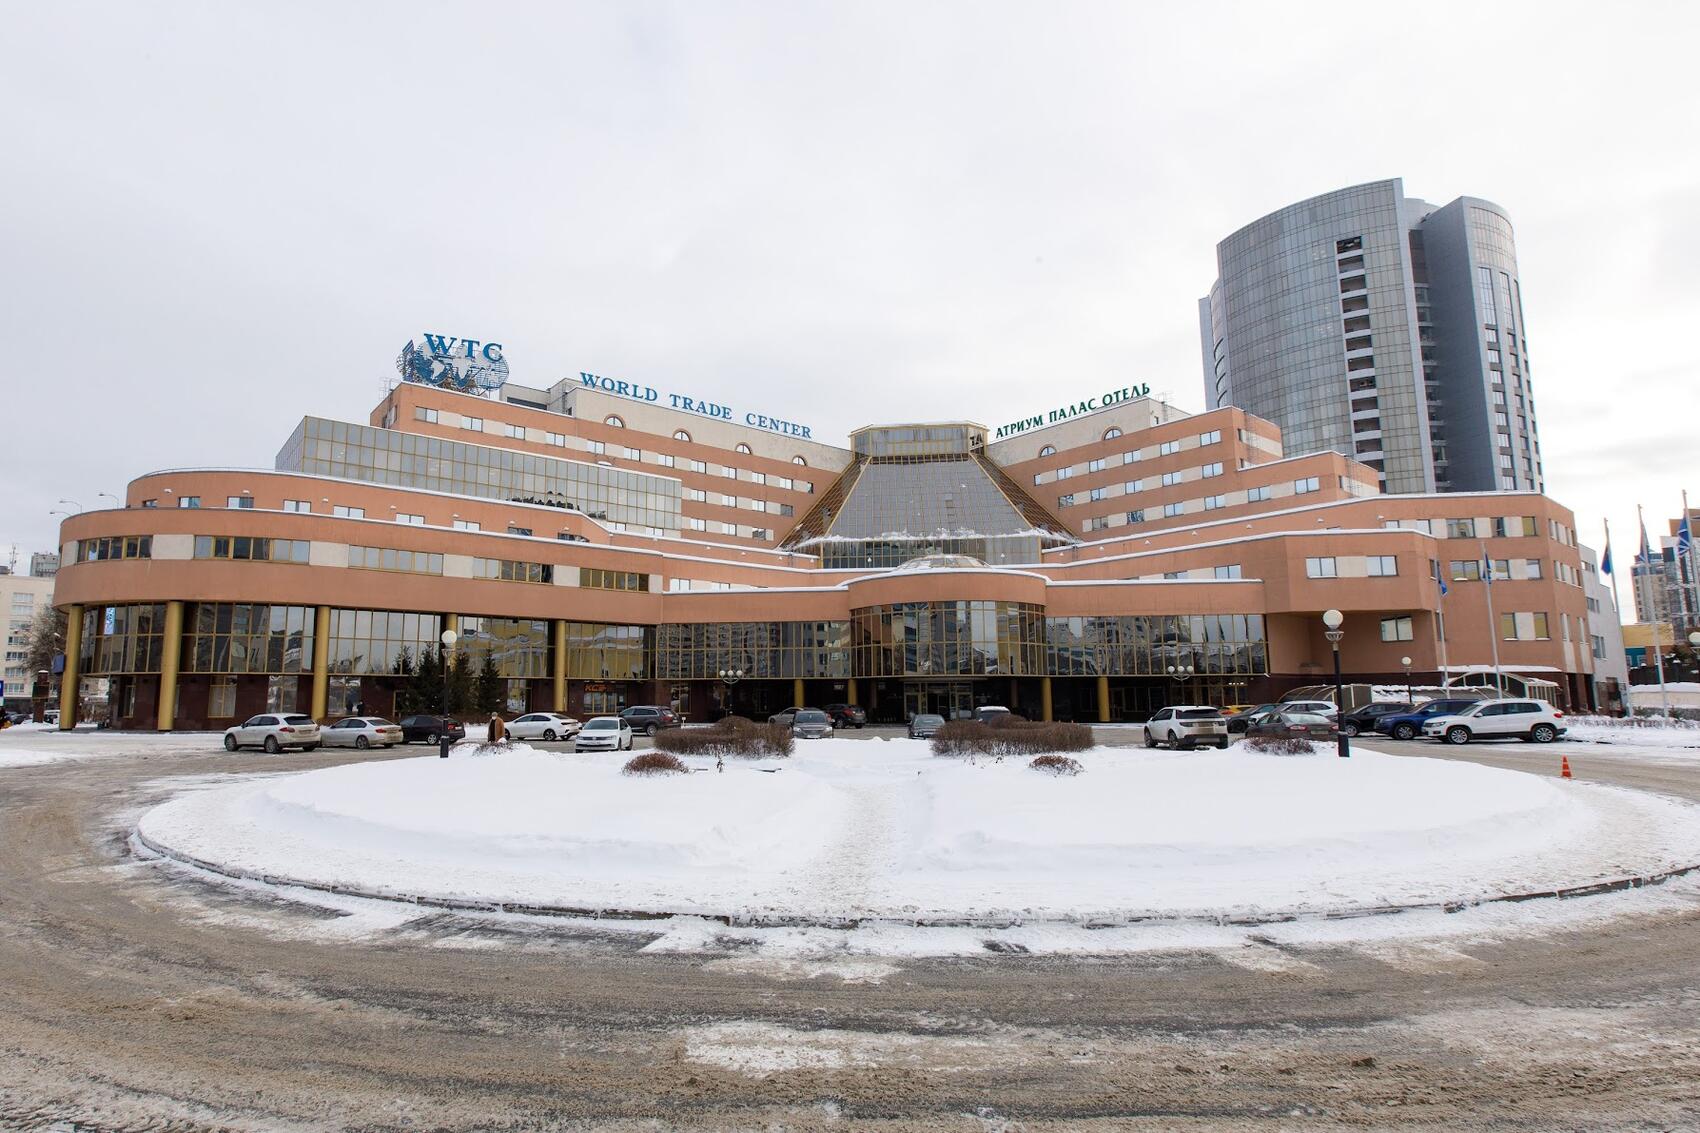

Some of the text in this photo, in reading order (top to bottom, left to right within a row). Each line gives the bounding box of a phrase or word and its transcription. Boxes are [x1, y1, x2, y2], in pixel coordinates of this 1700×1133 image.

[423, 333, 502, 362] WTC
[580, 372, 812, 439] WORLD TRADE CENTER
[995, 382, 1151, 438] АТРИУМ ПАЛАС ОТЕЛЬ
